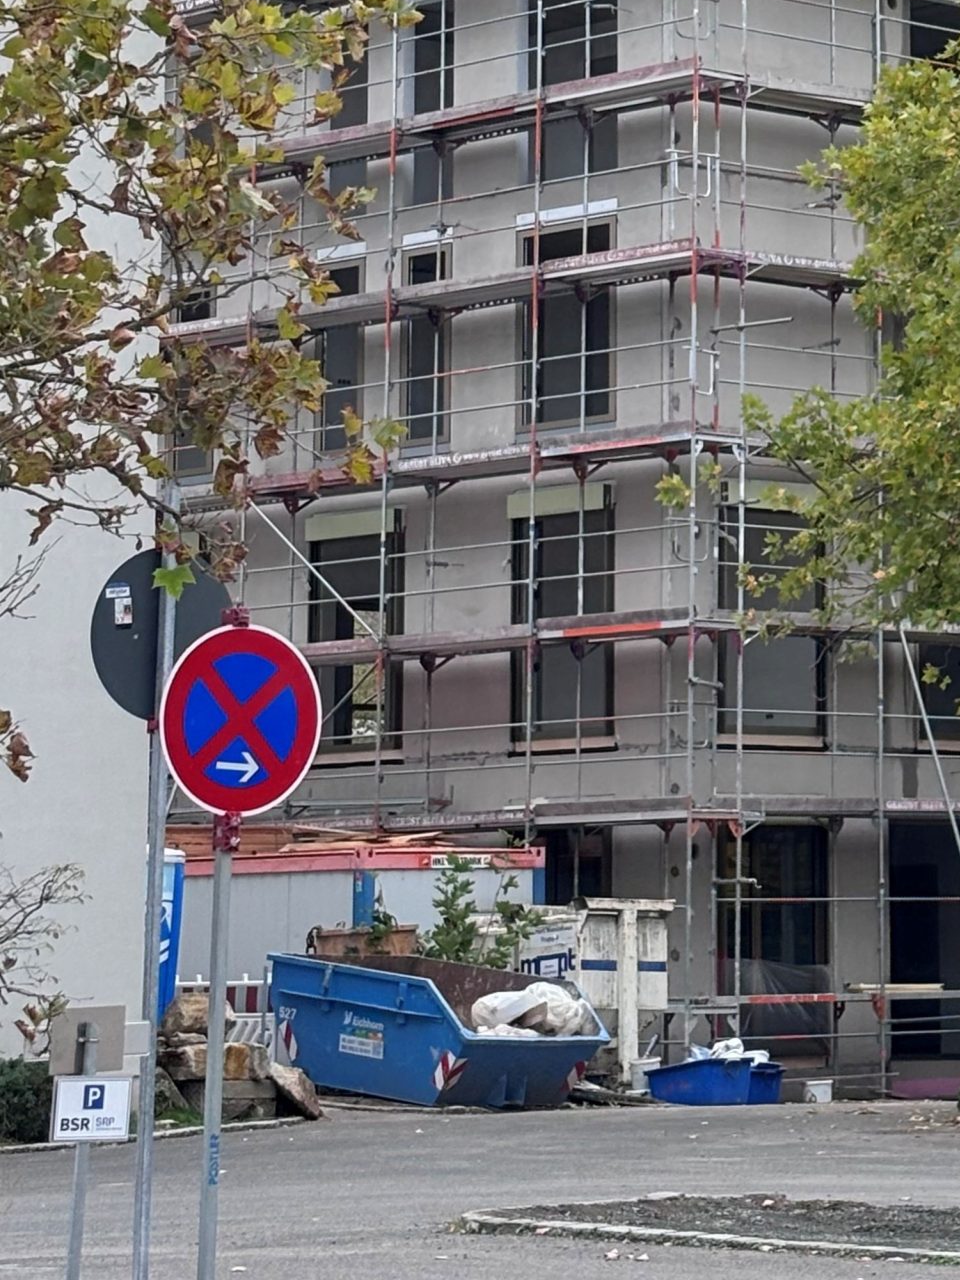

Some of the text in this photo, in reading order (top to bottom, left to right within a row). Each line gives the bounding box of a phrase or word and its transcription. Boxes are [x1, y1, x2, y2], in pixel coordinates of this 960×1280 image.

[279, 1006, 297, 1020] 527
[87, 1087, 101, 1108] P
[60, 1117, 91, 1132] BSR
